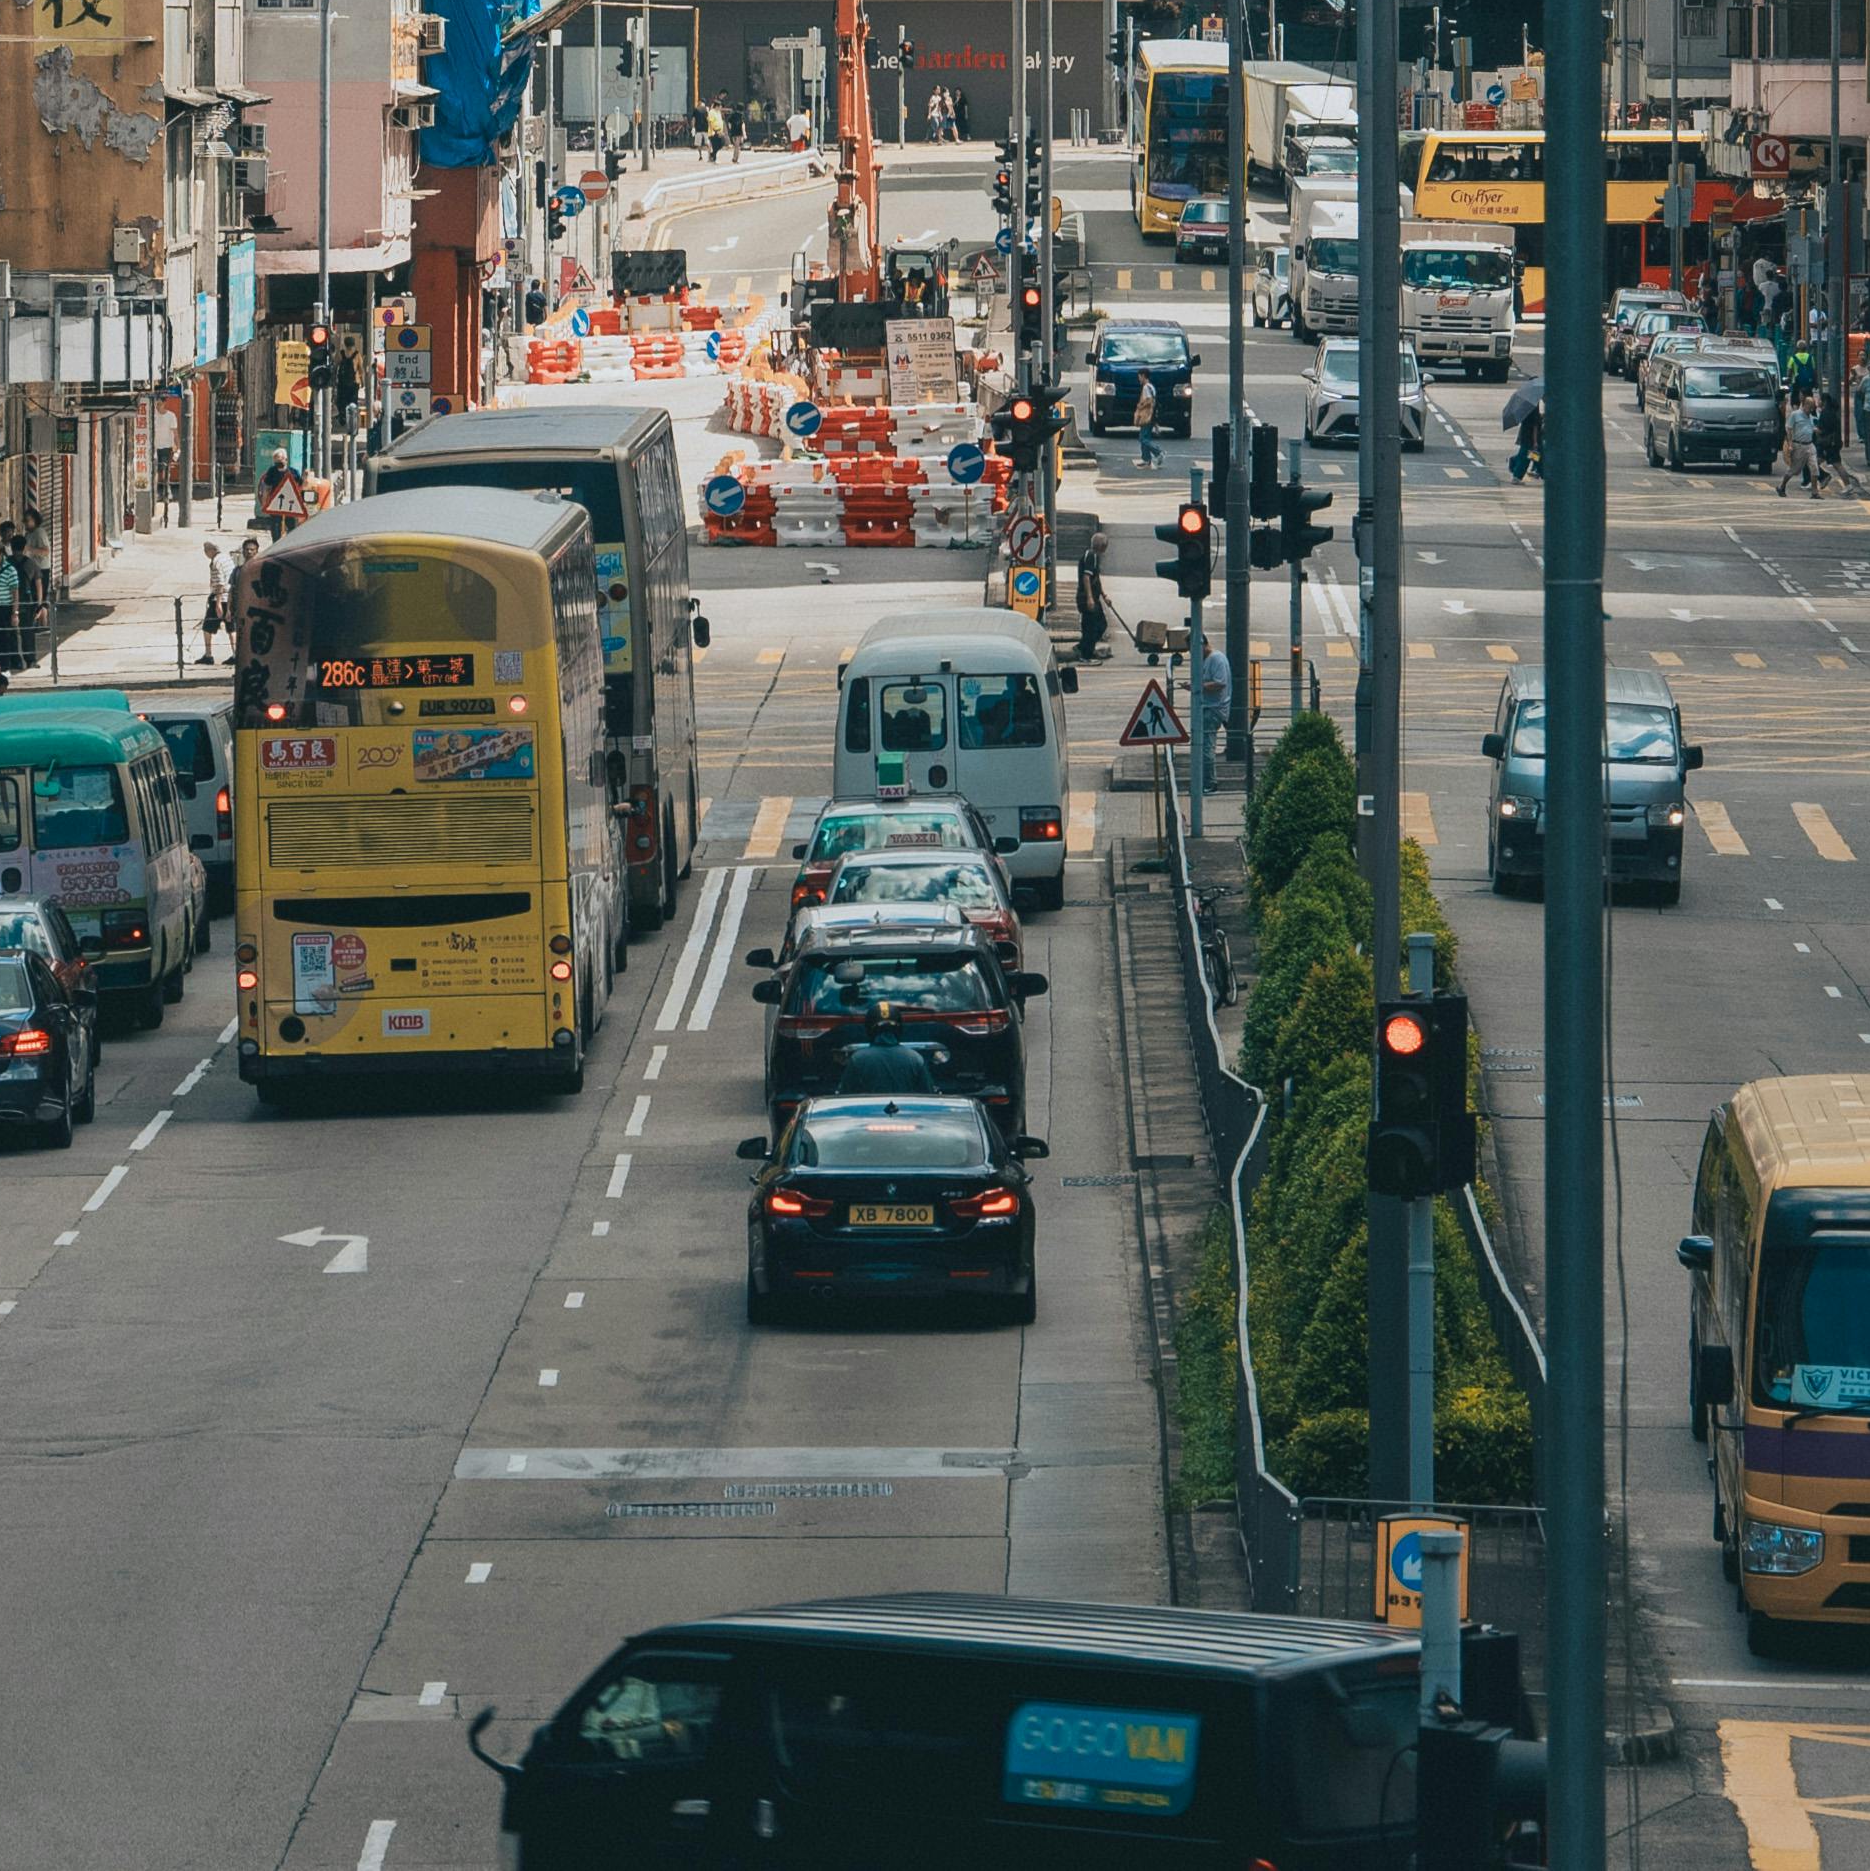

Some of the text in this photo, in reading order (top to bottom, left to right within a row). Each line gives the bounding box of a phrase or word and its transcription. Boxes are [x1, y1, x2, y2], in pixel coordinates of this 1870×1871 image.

[397, 354, 419, 365] End
[269, 740, 328, 761] 馬百良
[890, 833, 937, 843] TAXI
[388, 1014, 424, 1030] KMB
[855, 1208, 929, 1223] XB 7800
